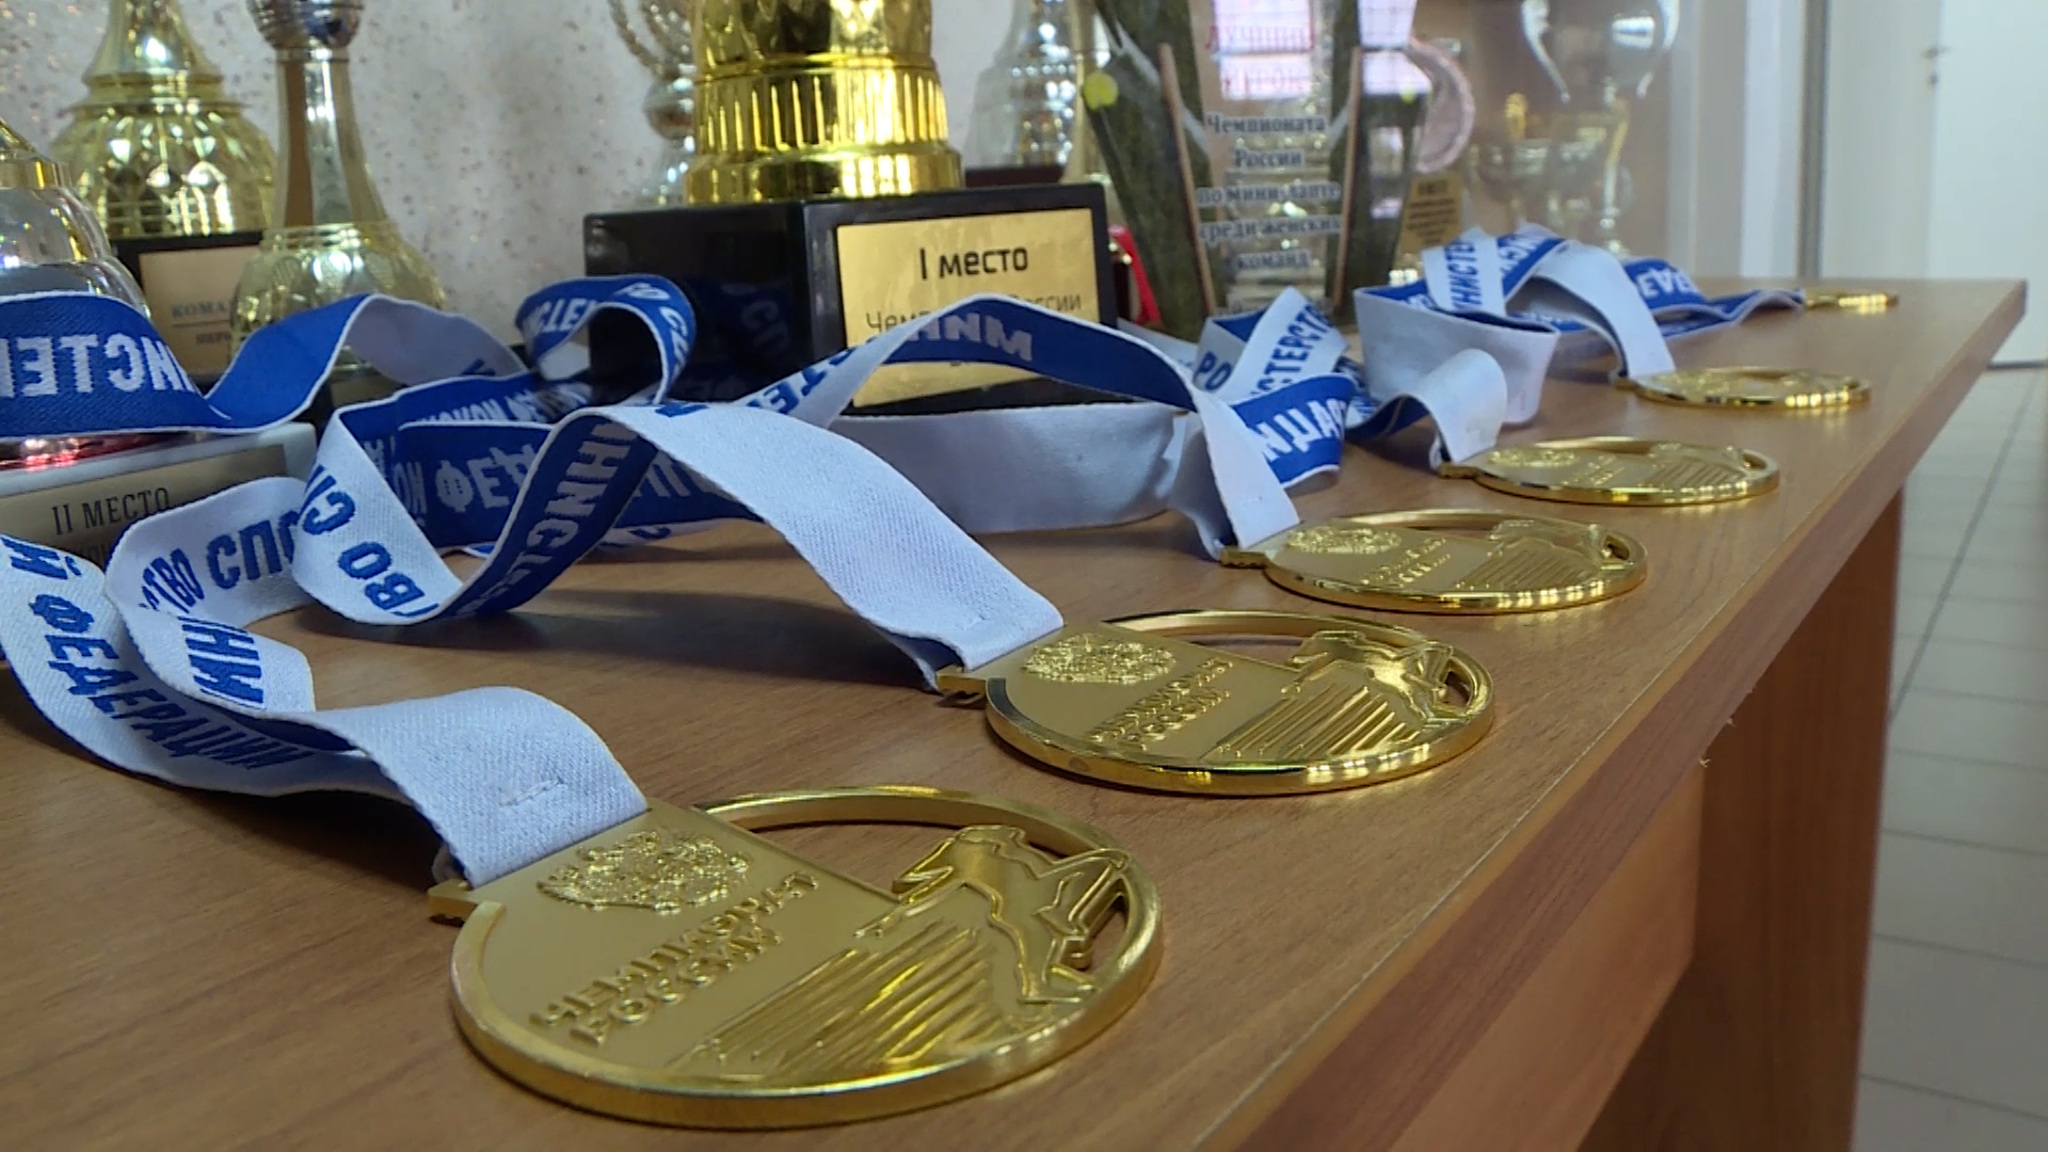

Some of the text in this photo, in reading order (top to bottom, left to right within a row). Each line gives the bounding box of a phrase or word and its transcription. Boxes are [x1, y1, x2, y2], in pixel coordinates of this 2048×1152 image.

[1235, 149, 1303, 168] России
[938, 246, 1029, 280] место
[865, 308, 932, 334] Чем
[83, 487, 170, 530] МЕСТО
